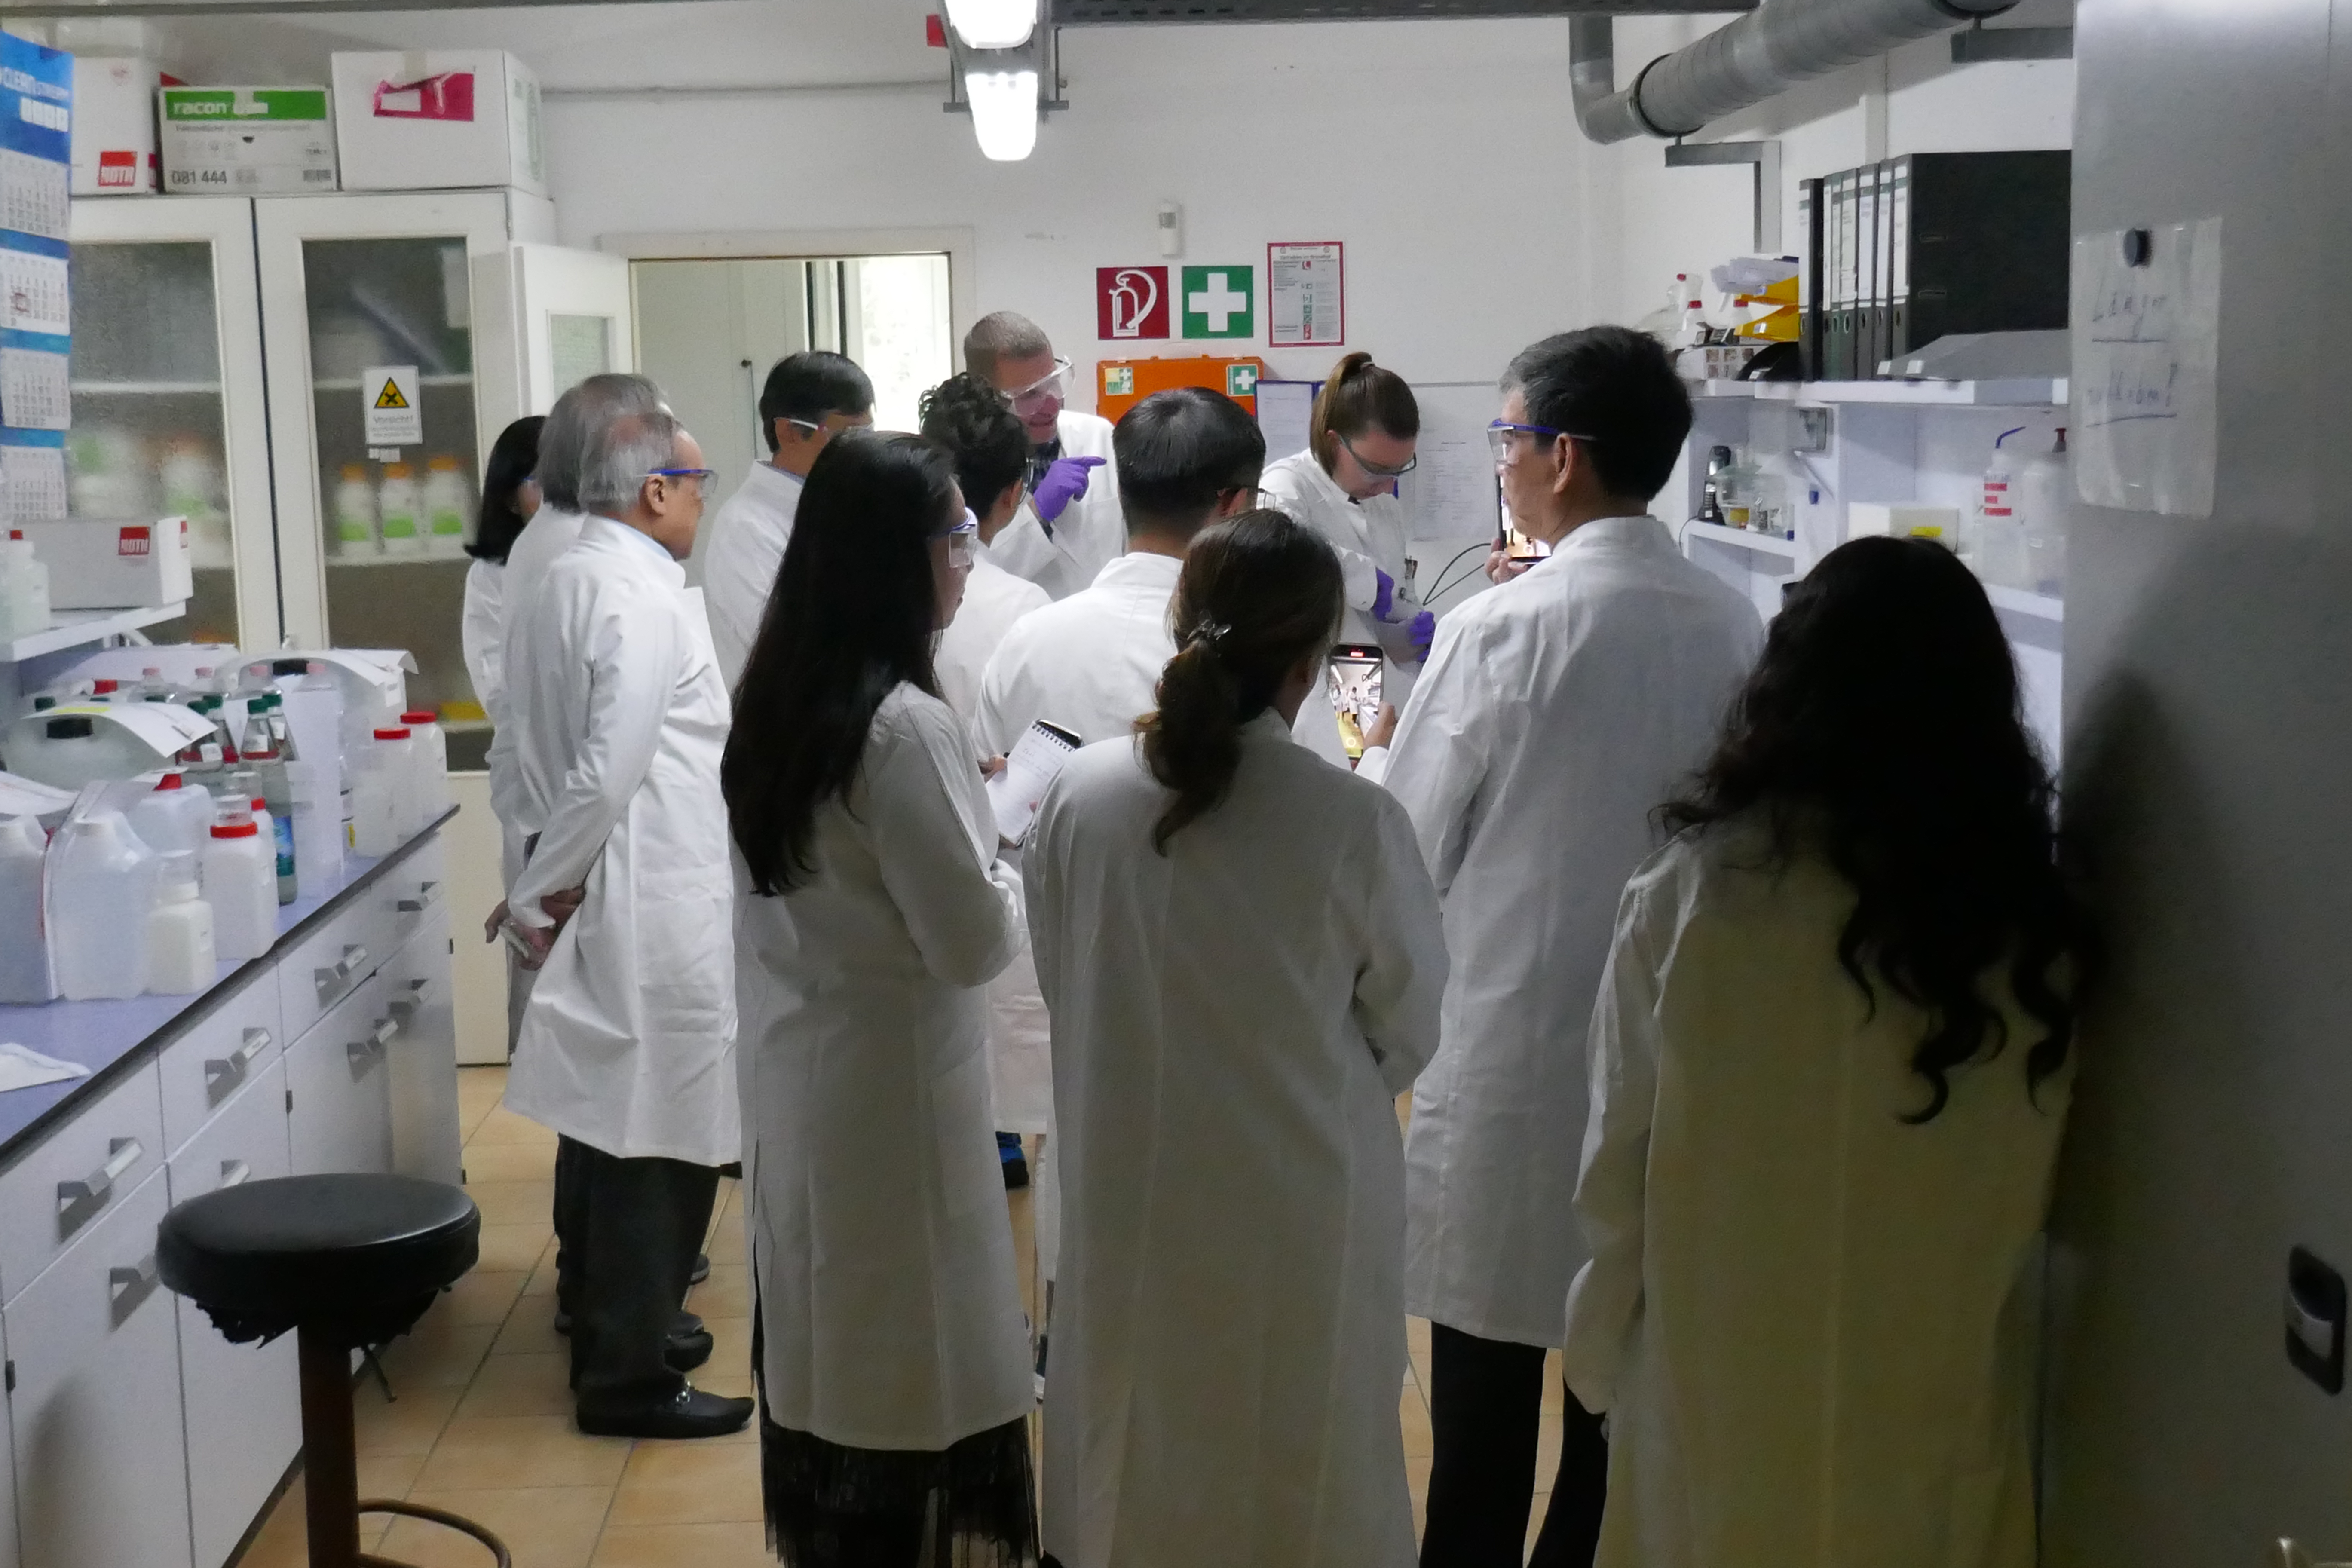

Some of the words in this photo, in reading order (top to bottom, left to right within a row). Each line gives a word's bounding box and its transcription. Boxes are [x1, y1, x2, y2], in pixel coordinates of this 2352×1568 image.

[174, 102, 227, 114] racon
[172, 170, 196, 184] 081
[201, 170, 227, 184] 444
